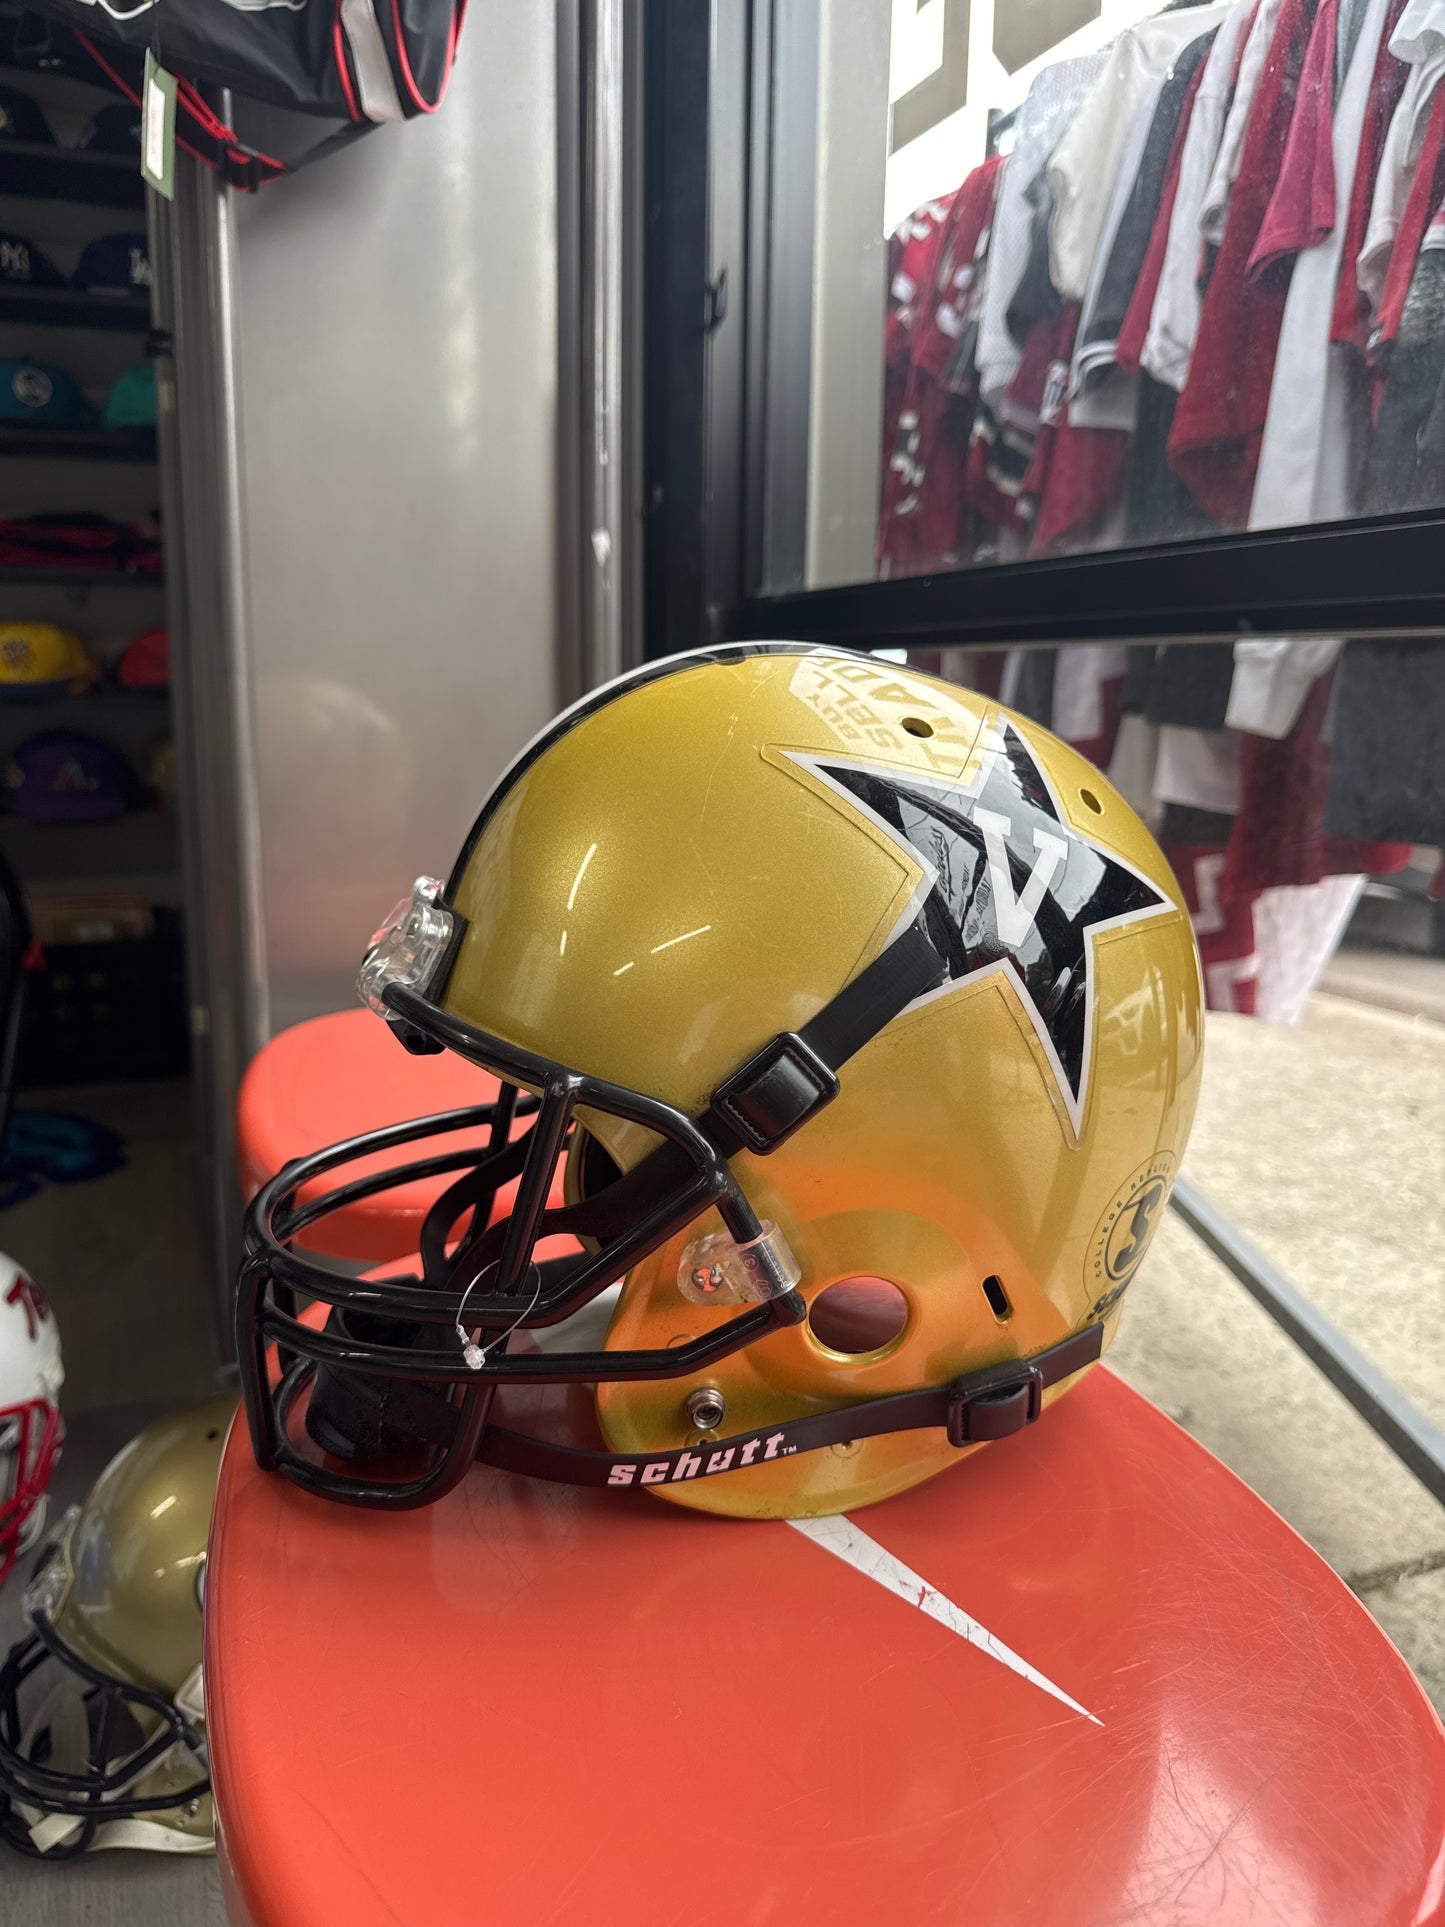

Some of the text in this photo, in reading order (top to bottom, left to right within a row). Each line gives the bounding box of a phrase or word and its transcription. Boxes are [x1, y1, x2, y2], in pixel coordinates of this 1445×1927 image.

[806, 695, 862, 741] BUY
[813, 670, 905, 750] SELL
[973, 806, 1068, 947] V
[1094, 1199, 1123, 1278] COLLEGE
[607, 1432, 785, 1487] schutt
